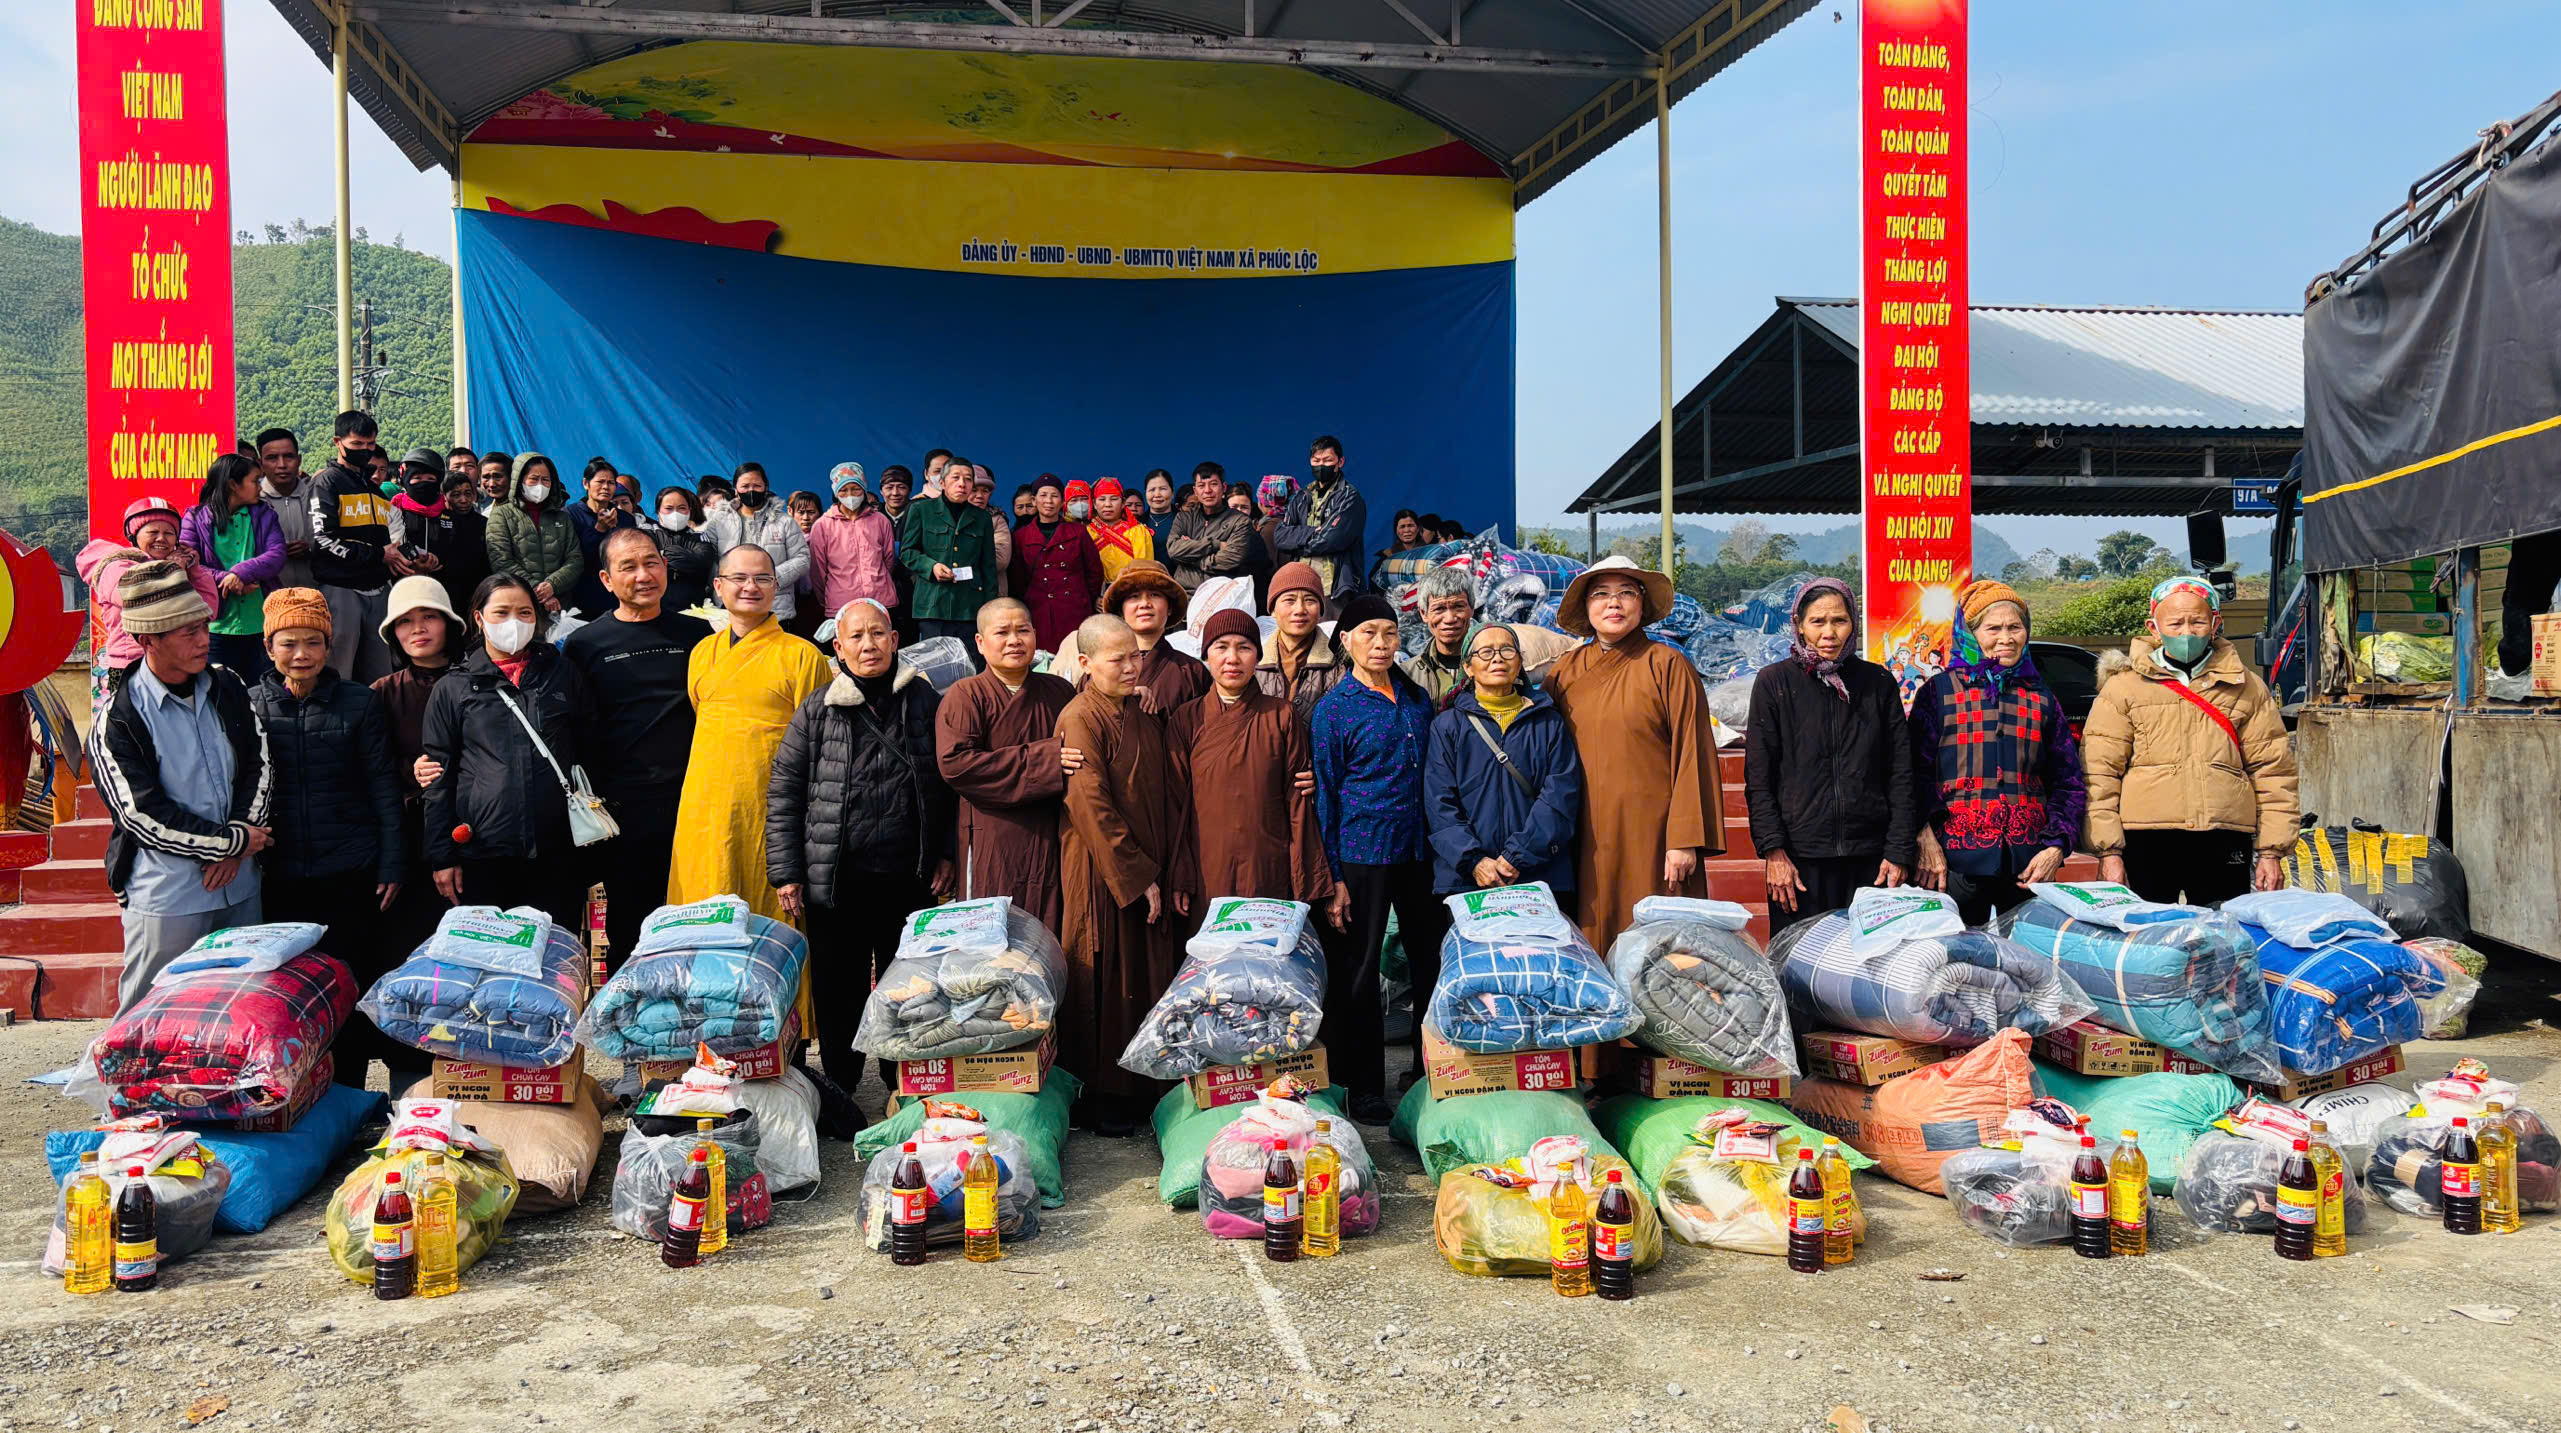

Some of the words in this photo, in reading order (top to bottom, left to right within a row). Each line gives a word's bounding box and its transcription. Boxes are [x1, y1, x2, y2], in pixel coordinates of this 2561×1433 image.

[1879, 38, 1911, 67] TOÀN
[1912, 36, 1950, 73] ĐẢNG,
[121, 58, 150, 135] VIỆT
[152, 72, 183, 120] NAM
[1883, 81, 1915, 110] TOÀN
[1917, 83, 1946, 116] DÂN,
[1881, 123, 1913, 153] TOÀN
[1915, 127, 1949, 157] QUÂN
[98, 148, 143, 208] NGƯỜI
[145, 151, 181, 209] LÃNH
[183, 164, 213, 226] ĐẠO
[1883, 164, 1922, 197] QUYẾT
[1923, 170, 1947, 198] TÂM
[1886, 212, 1916, 246] THỰC
[1917, 212, 1946, 247] HIỆN
[132, 224, 150, 300] TỔ
[153, 240, 188, 300] CHỨC
[962, 238, 998, 262] ĐẢNG
[1001, 239, 1018, 262] ỦY
[1030, 246, 1066, 264] HĐND
[1077, 247, 1112, 265] UBND
[1123, 248, 1174, 268] UBMTTQ
[1177, 246, 1203, 271] VIỆT
[1206, 250, 1235, 268] NAM
[1239, 248, 1255, 268] XÃ
[1259, 248, 1291, 269] PHÚC
[1294, 249, 1318, 273] LỘC
[1885, 247, 1925, 282] THẮNG
[1926, 258, 1947, 291] LỢI
[1881, 301, 1912, 333] NGHỊ
[1913, 291, 1951, 326] QUYẾT
[111, 341, 138, 404] MỌI
[141, 316, 187, 390] THẮNG
[190, 334, 213, 405] LỢI
[1894, 345, 1916, 373] ĐẠI
[1916, 340, 1939, 374] HỘI
[1890, 379, 1925, 411] ĐẢNG
[1926, 385, 1943, 418] BỘ
[111, 415, 137, 479] CỦA
[140, 417, 175, 480] CÁCH
[1894, 424, 1916, 454] CÁC
[1918, 420, 1942, 454] CẤP
[1873, 467, 1891, 496] VÀ
[1892, 474, 1923, 503] NGHỊ
[1924, 463, 1962, 497] QUYẾT
[1886, 516, 1909, 546] ĐẠI
[1909, 511, 1933, 546] HỘI
[1933, 516, 1954, 540] XIV
[1888, 551, 1912, 582] CỦA
[1914, 551, 1953, 583] ĐẢNG!
[928, 1059, 947, 1075] 30
[1236, 1065, 1255, 1080] 30
[1533, 1055, 1551, 1063] TÔM
[2353, 1065, 2370, 1082] 30
[513, 1085, 532, 1100] 30
[535, 1085, 553, 1094] gói
[1454, 1087, 1475, 1096] NGON
[1525, 1073, 1544, 1089] 30
[1545, 1072, 1564, 1081] gói
[1731, 1080, 1750, 1097] 30
[1752, 1080, 1771, 1089] gói
[1863, 1121, 1885, 1144] 908
